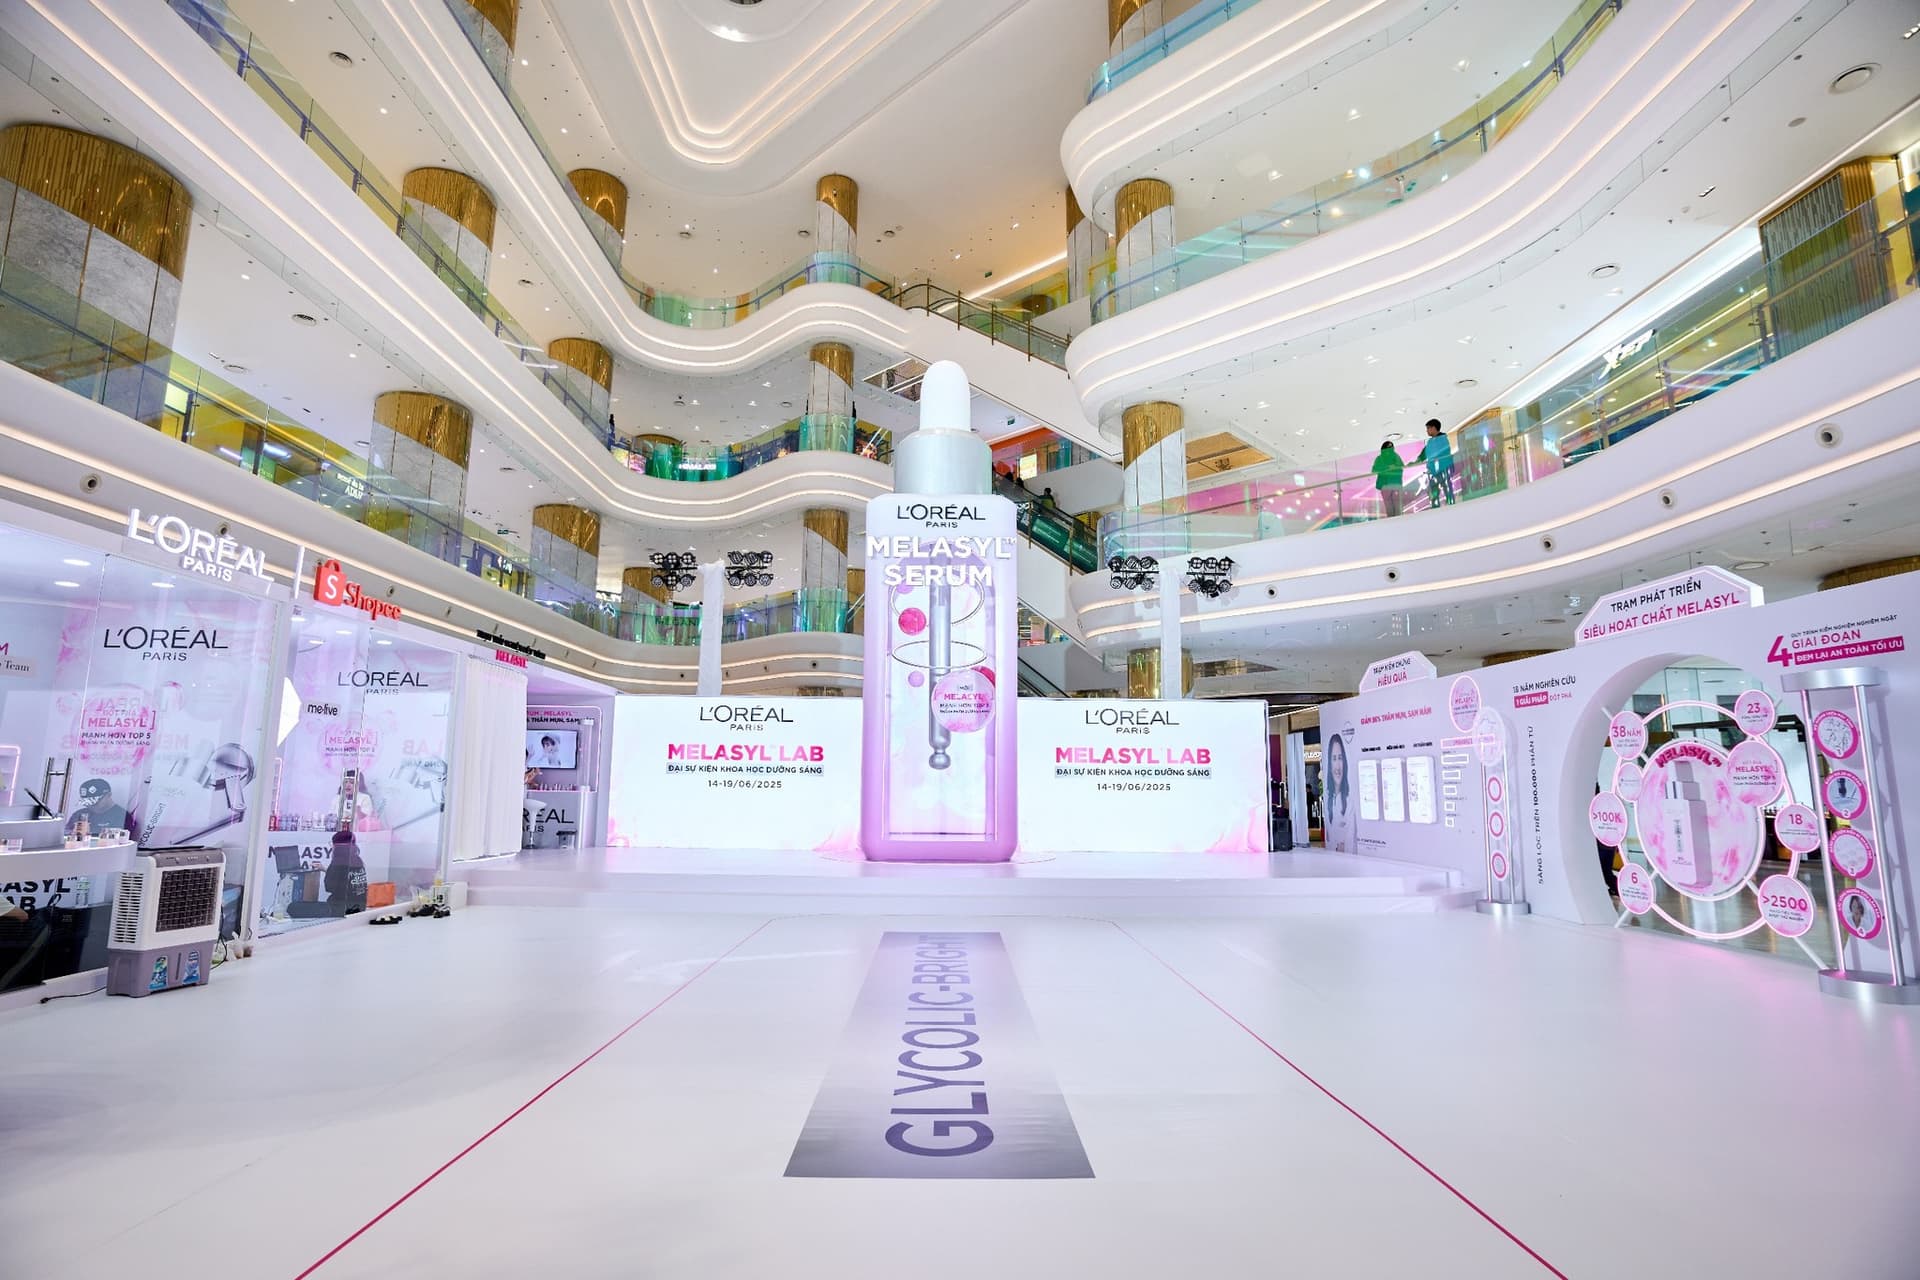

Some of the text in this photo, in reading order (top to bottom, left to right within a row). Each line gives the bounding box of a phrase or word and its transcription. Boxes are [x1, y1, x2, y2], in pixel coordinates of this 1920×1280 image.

[897, 504, 985, 520] L'ORÉAL
[128, 508, 275, 581] L'ORÉAL
[182, 556, 233, 582] PARIS
[884, 564, 993, 586] SERUM
[344, 583, 401, 620] Shopee
[1611, 577, 1702, 612] TRẠM PHÁT TRIỂN
[1583, 625, 1606, 639] SIÊU
[1642, 603, 1673, 626] CHẤT
[104, 626, 228, 650] L'ORÉAL
[1792, 629, 1861, 649] GIAI ĐOẠN
[142, 652, 187, 661] PARIS
[1767, 635, 1793, 667] 4
[1797, 653, 1814, 662] ĐEM
[1816, 652, 1829, 661] LẠI
[1844, 643, 1869, 656] TOÀN
[4, 660, 30, 671] Team
[338, 670, 428, 687] L'ORÉAL
[700, 705, 794, 722] L'ORÉAL
[1747, 703, 1761, 713] 23
[87, 718, 148, 728] MELASYL
[1085, 709, 1180, 726] L'ORÉAL
[1612, 726, 1626, 737] 38
[328, 736, 373, 744] MELASYL
[779, 745, 824, 761] LAB
[1167, 748, 1211, 764] LAB
[668, 764, 683, 773] ĐẠI
[799, 765, 822, 774] SÁNG
[1056, 768, 1071, 776] ĐẠI
[1109, 768, 1132, 776] KHOA
[1155, 768, 1184, 776] DƯỠNG
[1187, 768, 1210, 776] SÁNG
[708, 779, 782, 788] 14-19/06/2025
[1097, 782, 1171, 791] 14-19/06/2025
[1592, 811, 1622, 823] >100K
[1788, 814, 1803, 825] 18
[1631, 872, 1638, 884] 6
[1763, 895, 1808, 911] >2500
[885, 935, 994, 1157] GLYCOLIC-BRIGHT
